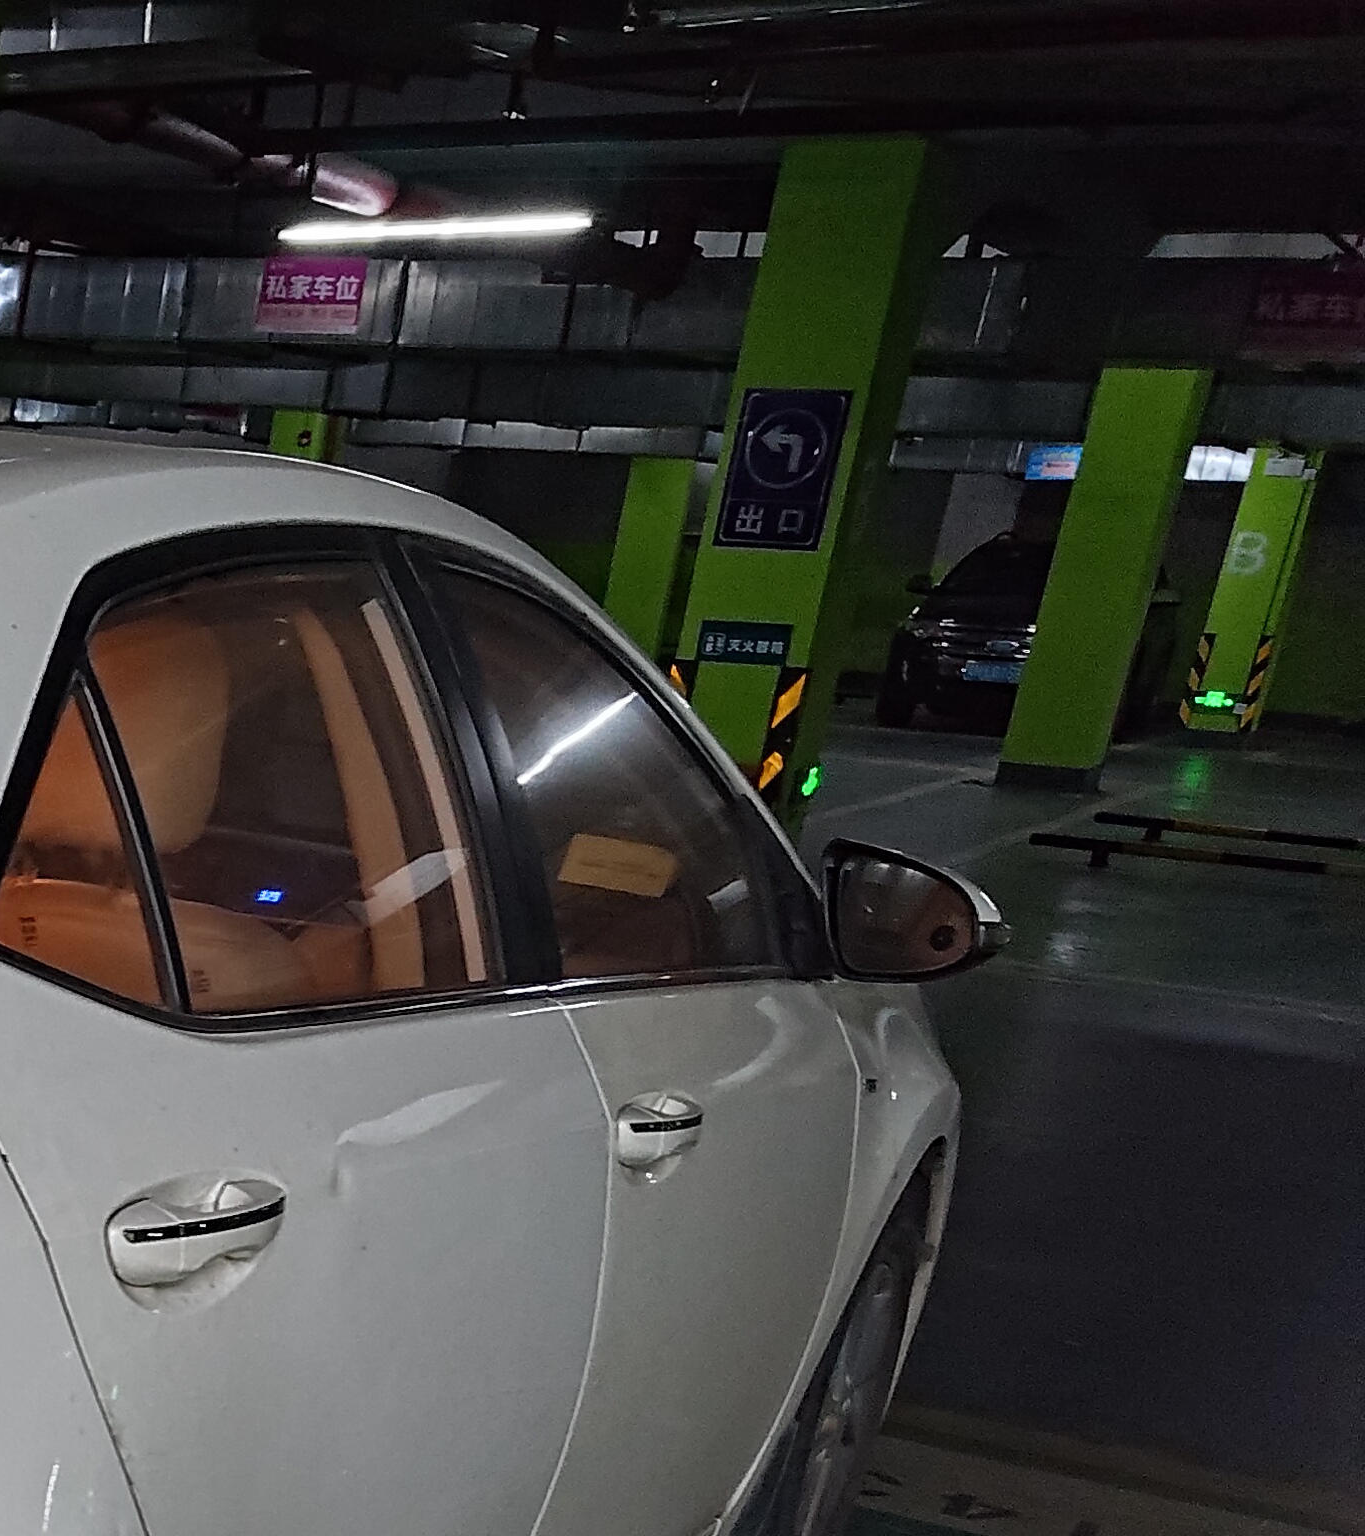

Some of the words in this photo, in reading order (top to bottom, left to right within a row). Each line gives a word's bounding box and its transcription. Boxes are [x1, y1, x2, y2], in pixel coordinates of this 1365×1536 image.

[265, 274, 362, 300] 私家车位
[734, 503, 805, 535] 出口
[1228, 530, 1267, 574] B
